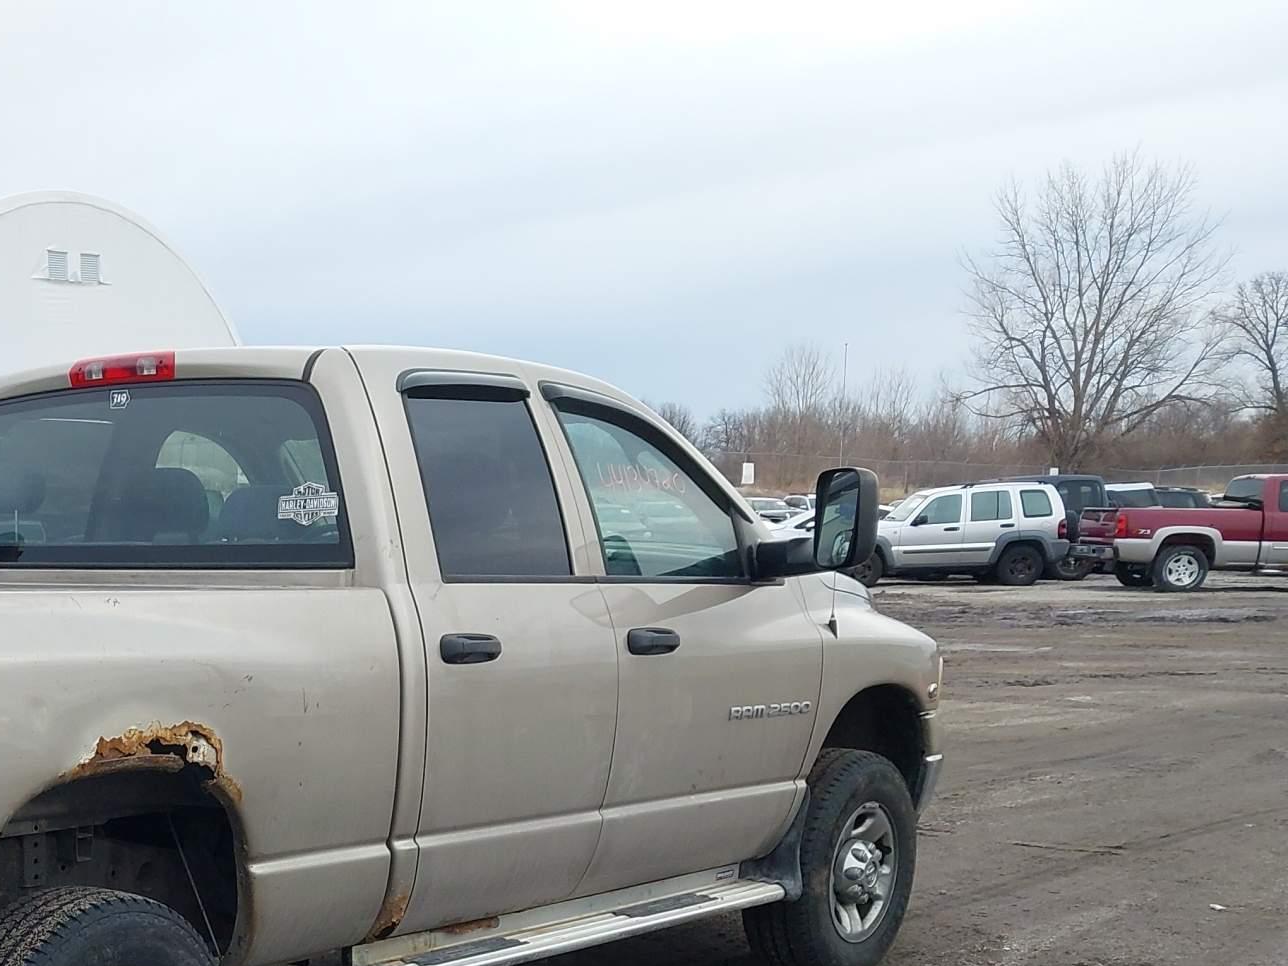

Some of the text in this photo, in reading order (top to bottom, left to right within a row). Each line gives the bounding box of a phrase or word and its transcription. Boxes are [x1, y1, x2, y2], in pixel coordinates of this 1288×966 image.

[281, 498, 336, 510] HARLEY-DAVIDSON
[728, 700, 811, 720] RAM 2500
